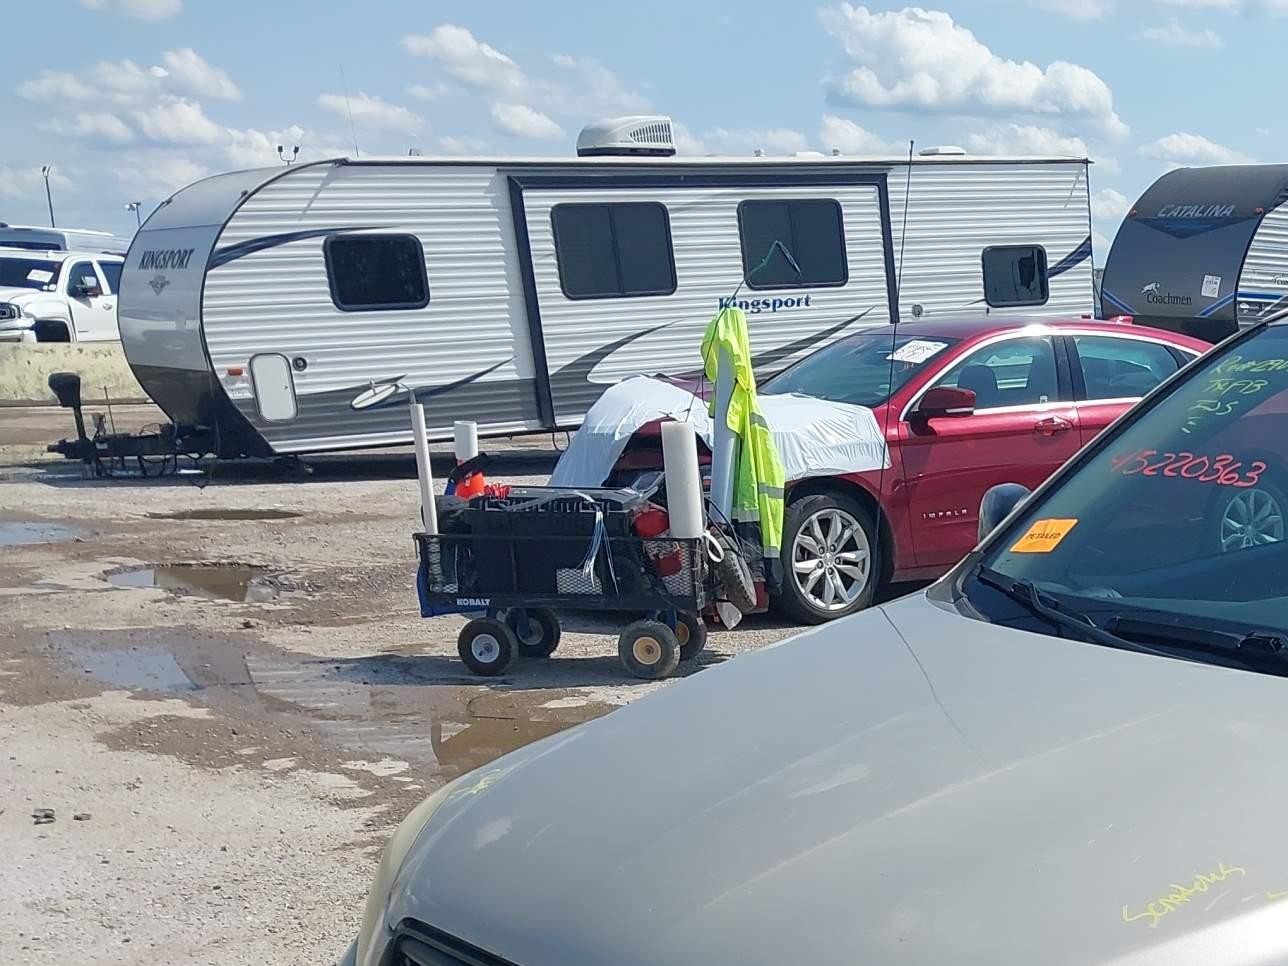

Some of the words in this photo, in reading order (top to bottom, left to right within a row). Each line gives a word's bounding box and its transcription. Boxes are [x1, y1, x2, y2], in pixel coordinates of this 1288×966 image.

[1158, 204, 1235, 217] CATALINA
[138, 248, 195, 269] KINGSPORT
[718, 294, 812, 313] Kingsport
[1146, 292, 1192, 305] Coachmen
[1111, 449, 1267, 487] 45220363
[922, 509, 967, 519] IMPALA
[456, 598, 491, 606] KOBALT
